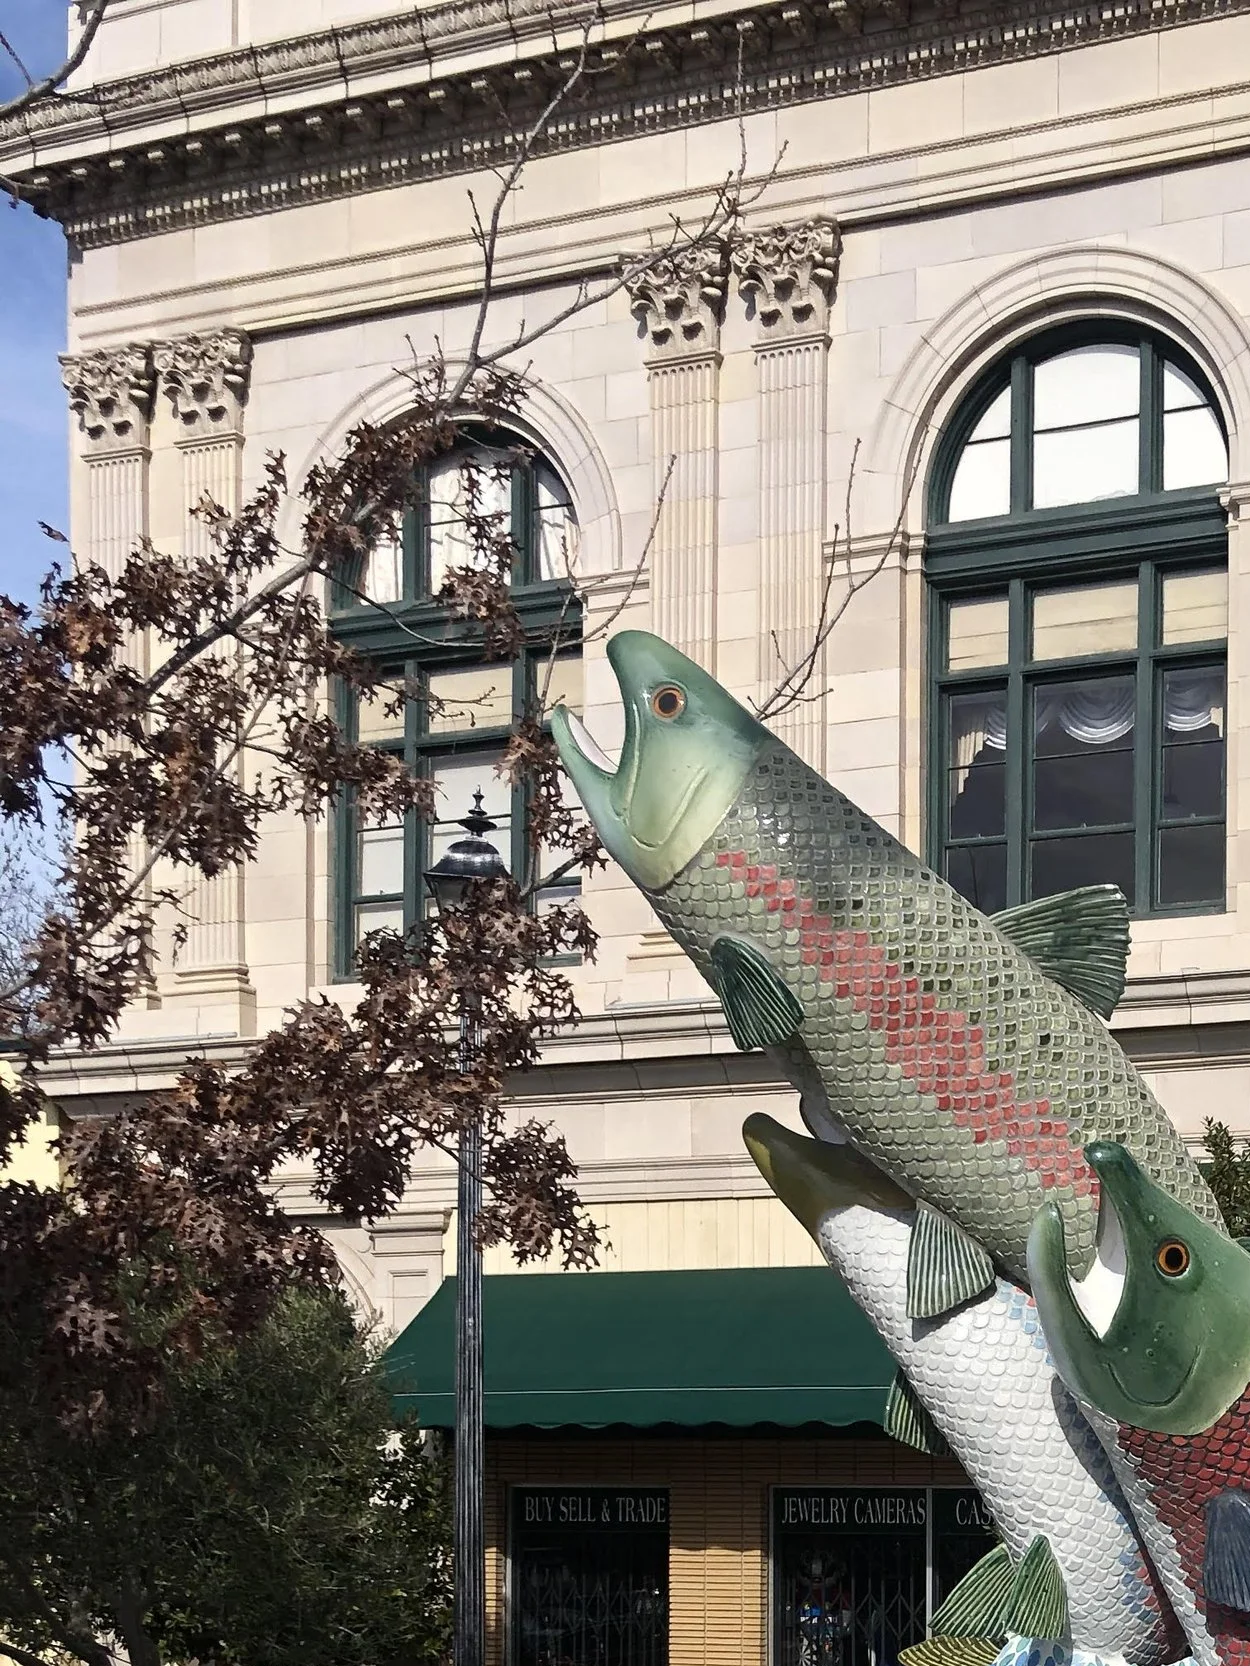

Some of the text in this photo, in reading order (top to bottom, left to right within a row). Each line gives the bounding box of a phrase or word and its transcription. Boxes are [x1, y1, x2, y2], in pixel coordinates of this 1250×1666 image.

[525, 1496, 666, 1523] BUY SELL & TRADE
[782, 1497, 926, 1525] JEWELRY CAMERAS
[956, 1497, 996, 1526] CAS
